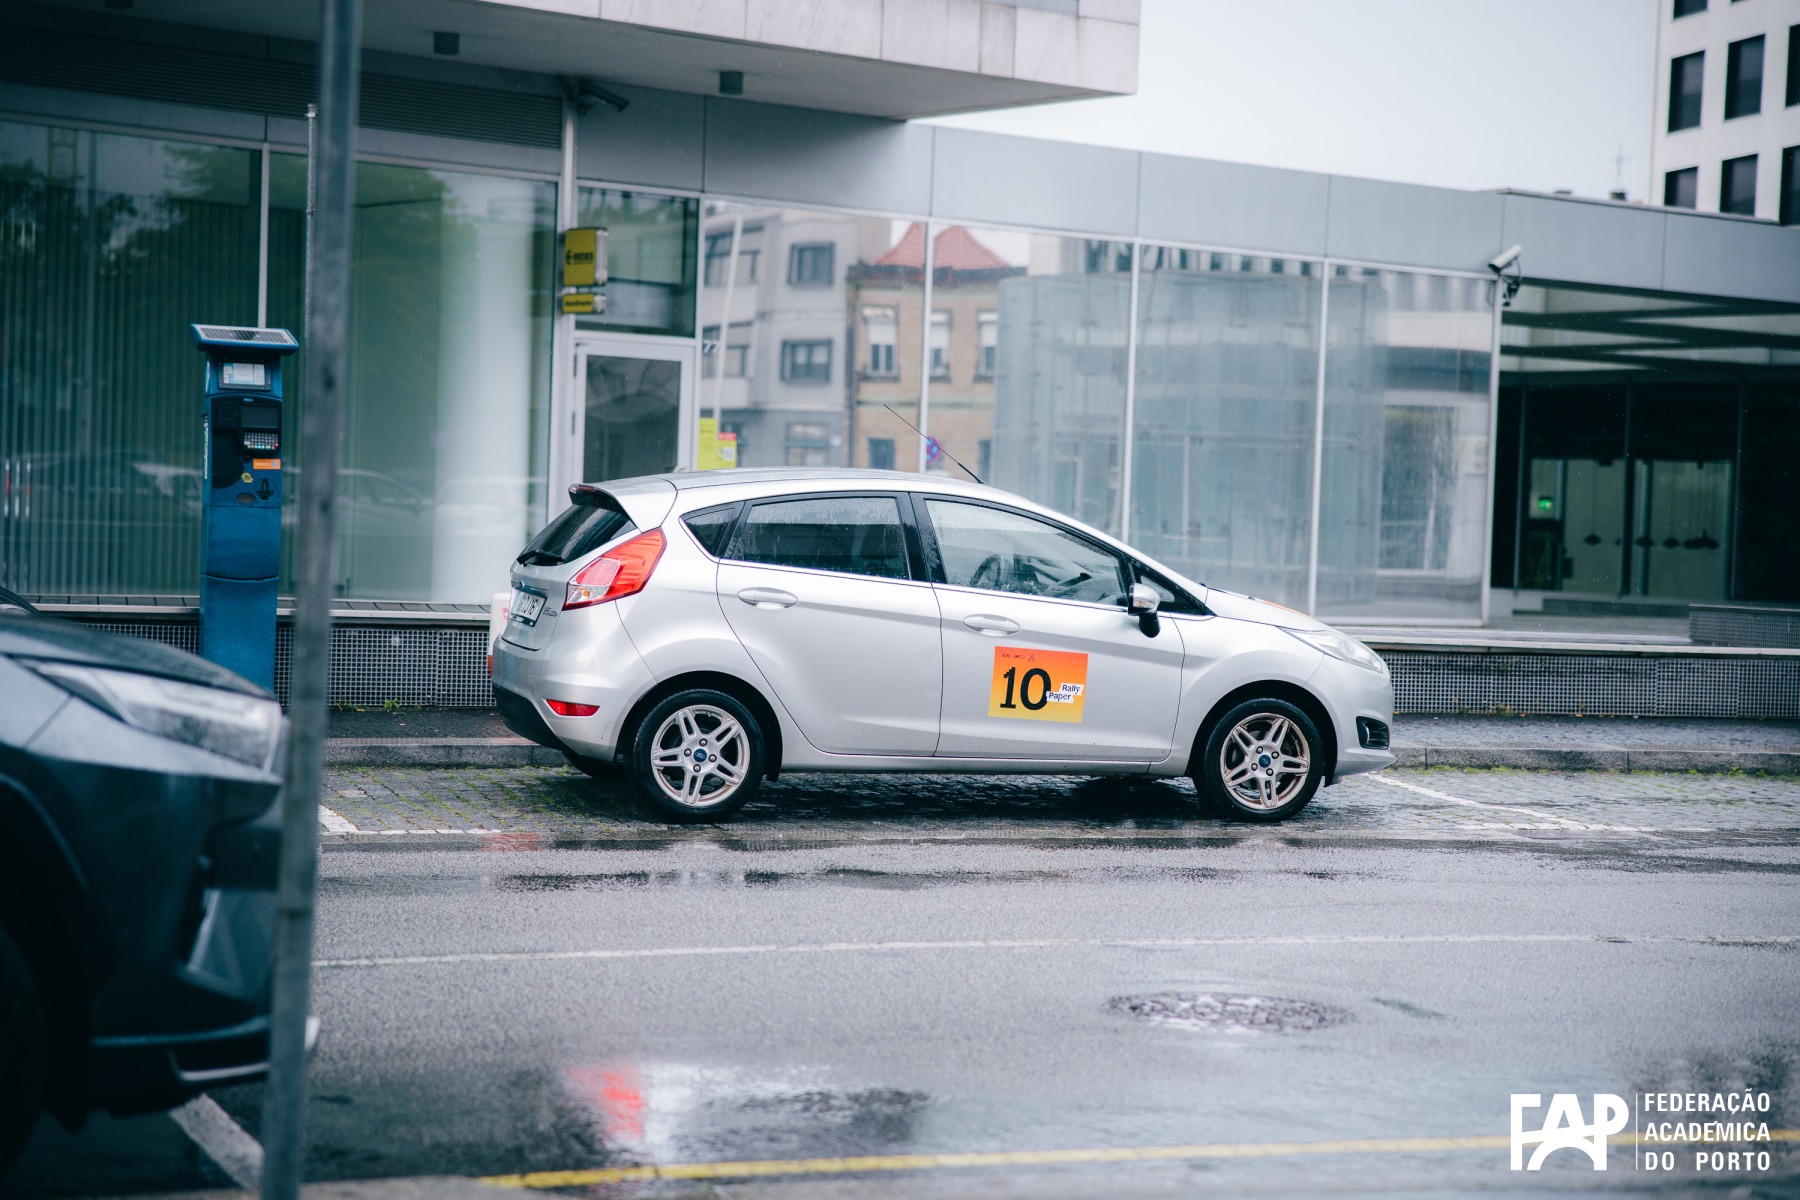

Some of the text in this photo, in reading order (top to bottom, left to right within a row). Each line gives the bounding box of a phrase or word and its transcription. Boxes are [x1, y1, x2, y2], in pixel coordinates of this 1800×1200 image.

[703, 340, 720, 354] 77
[1000, 666, 1052, 710] 10
[1062, 684, 1081, 694] Rally
[1048, 692, 1072, 702] Paper
